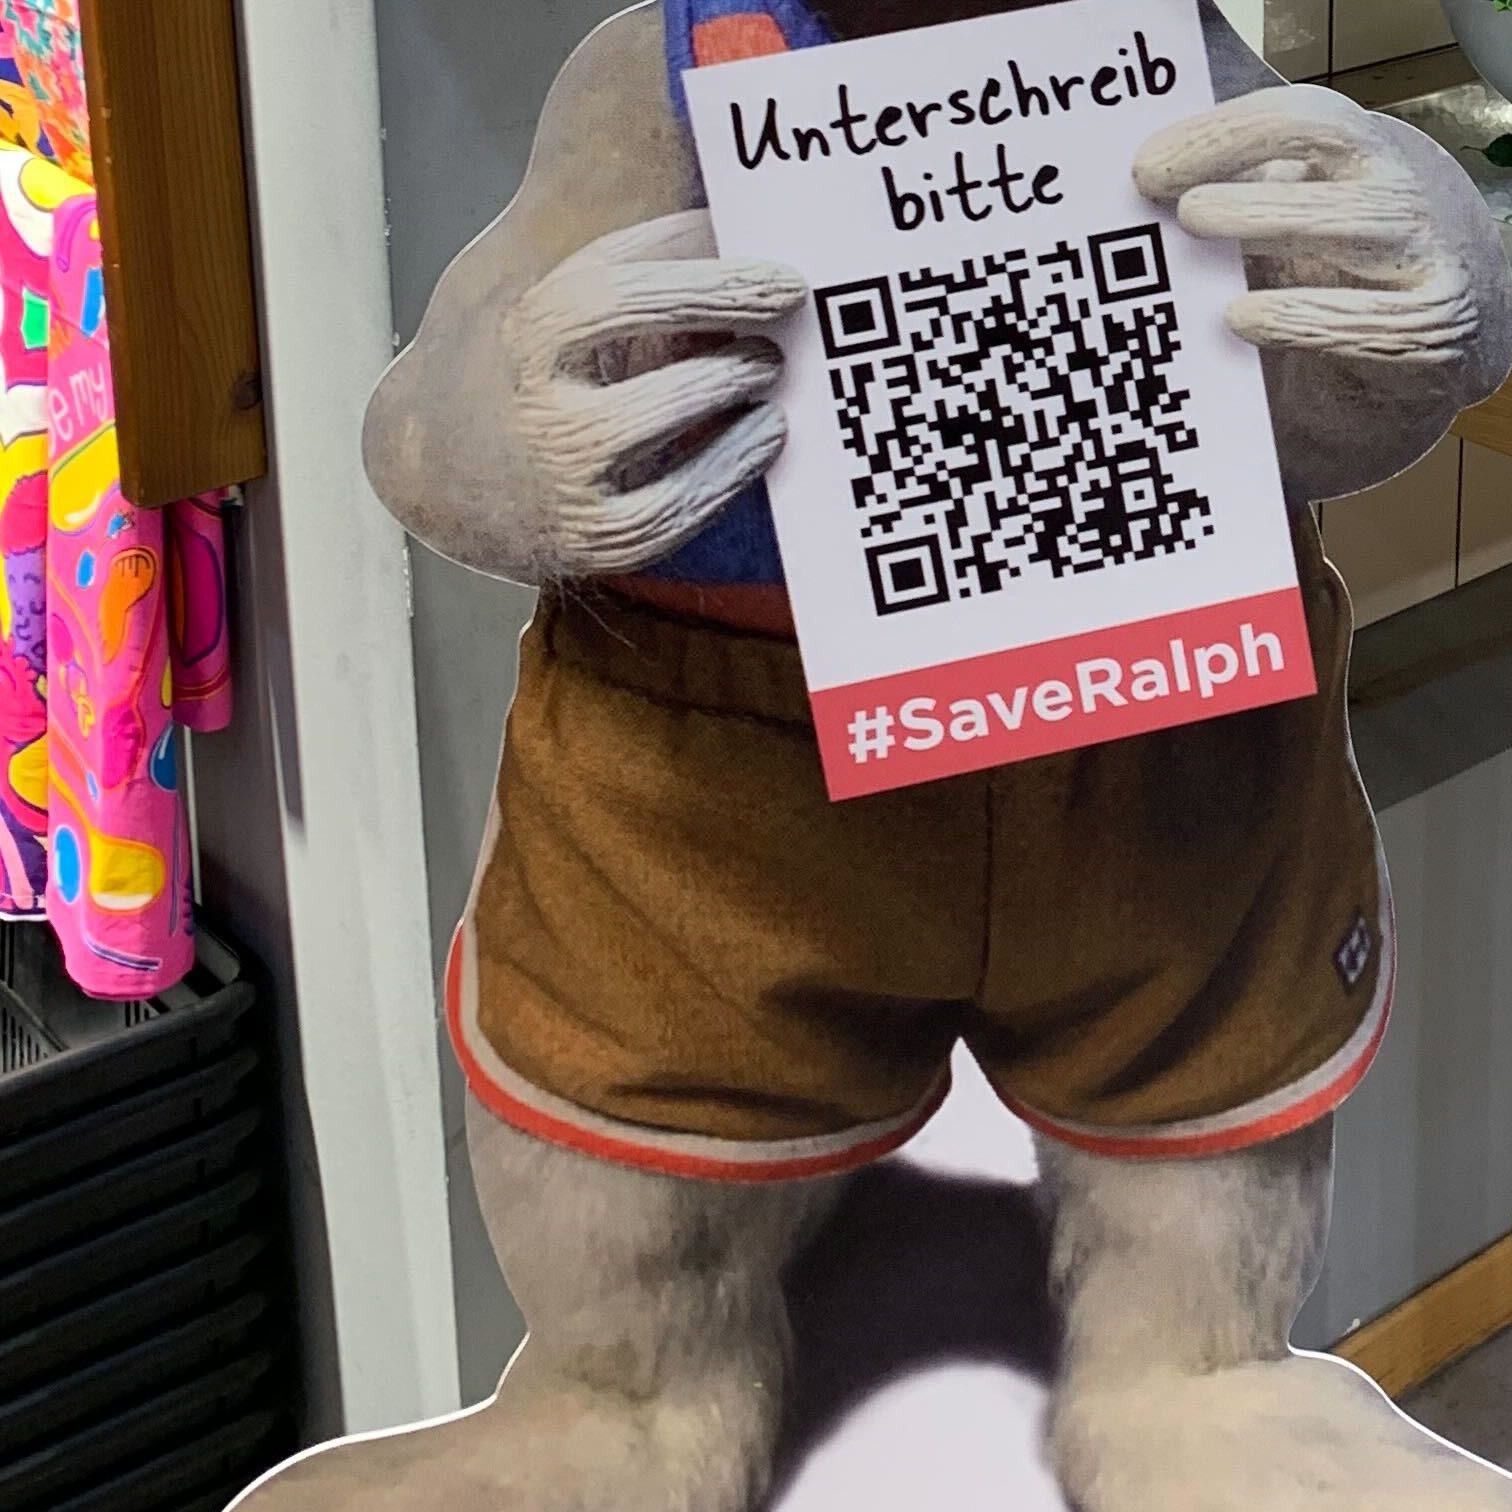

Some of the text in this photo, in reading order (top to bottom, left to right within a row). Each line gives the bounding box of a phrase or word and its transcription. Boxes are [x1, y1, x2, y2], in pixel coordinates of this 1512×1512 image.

[730, 31, 1178, 170] Unterschreib
[882, 144, 1065, 231] bitte
[847, 622, 1286, 763] #SaveRalph
